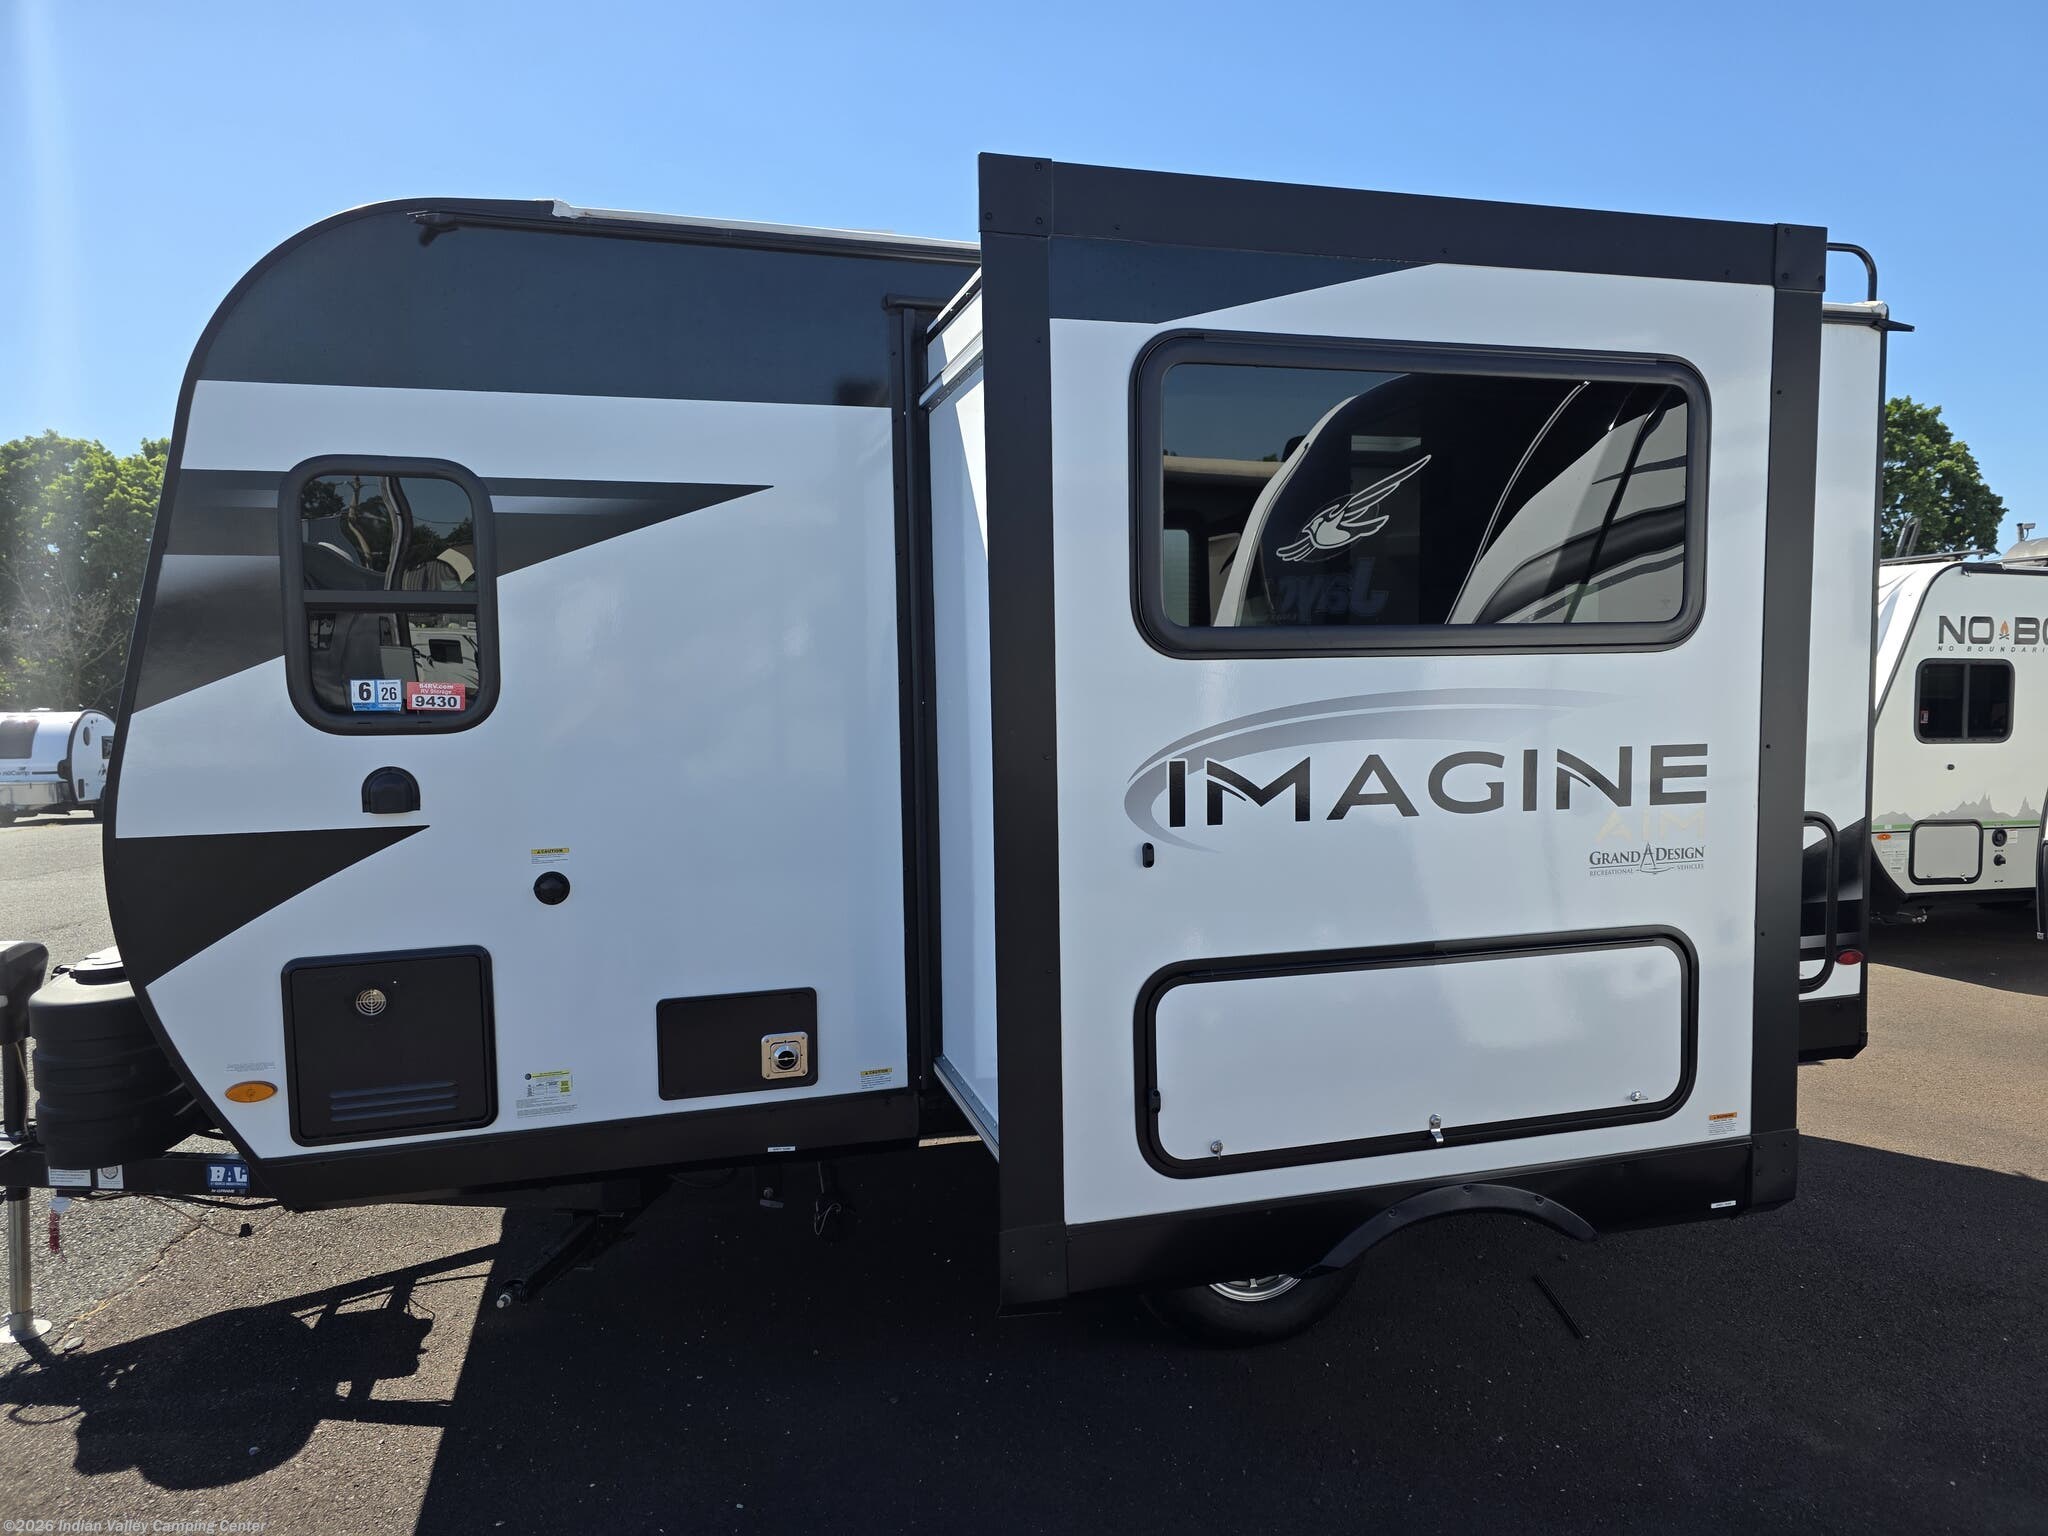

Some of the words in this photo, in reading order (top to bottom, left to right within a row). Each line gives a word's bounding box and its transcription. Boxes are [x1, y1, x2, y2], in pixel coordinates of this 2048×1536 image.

[2013, 617, 2048, 646] B
[358, 682, 372, 701] 6
[381, 686, 398, 701] 26
[415, 695, 458, 708] 9430
[1168, 743, 1708, 828] IMAGINE
[1588, 850, 1641, 866] GRAND
[1655, 846, 1705, 861] DESIGN
[210, 1166, 248, 1182] BAL
